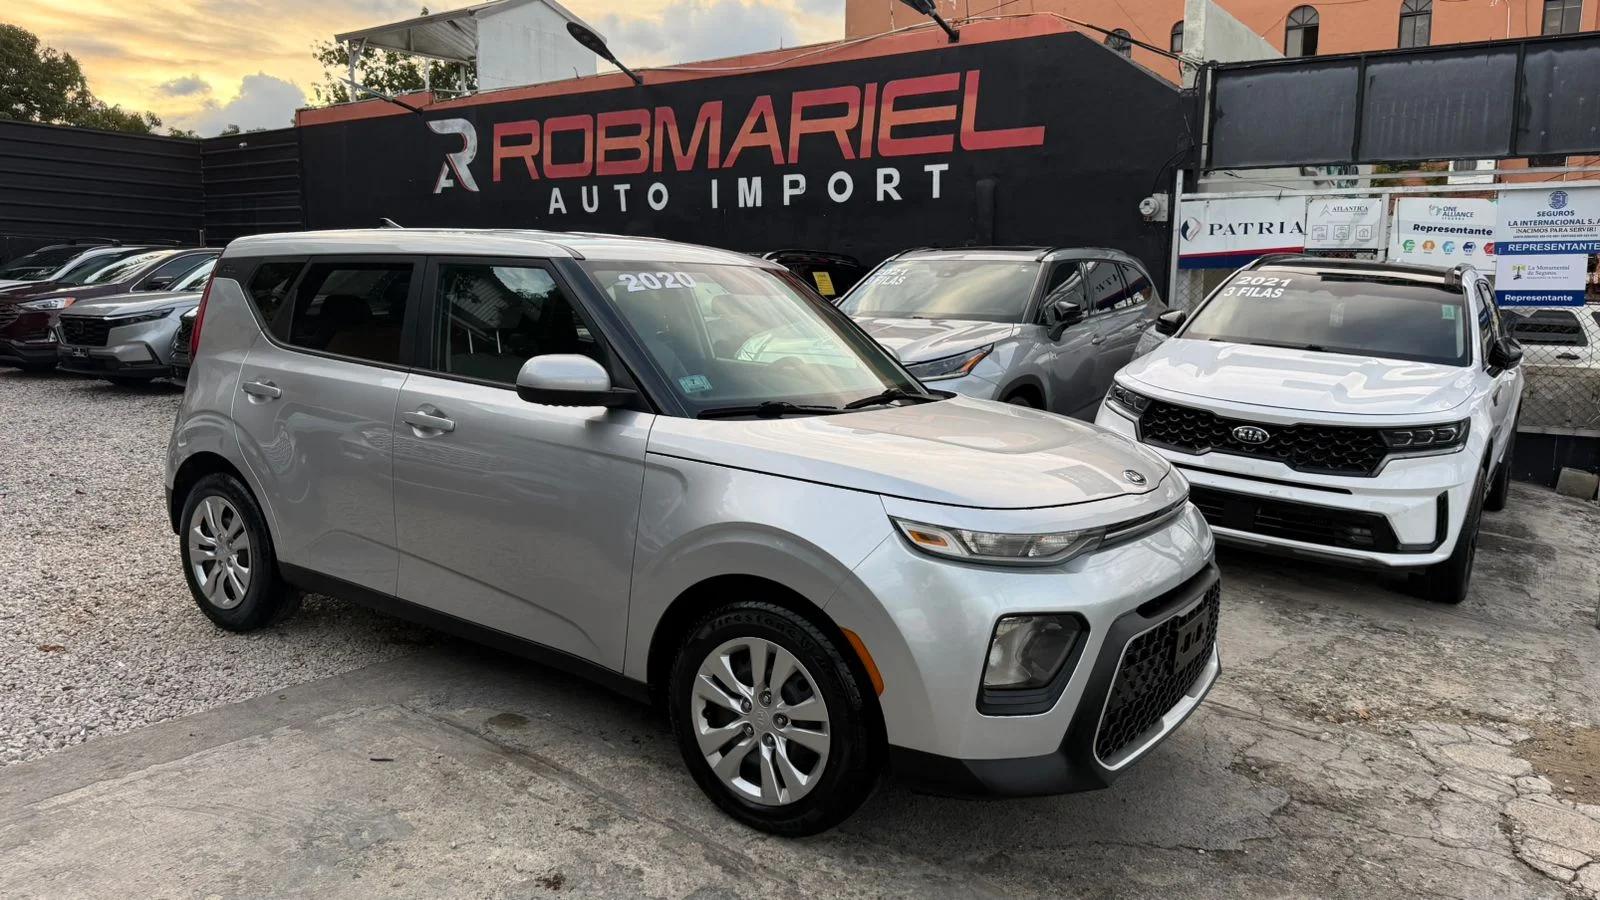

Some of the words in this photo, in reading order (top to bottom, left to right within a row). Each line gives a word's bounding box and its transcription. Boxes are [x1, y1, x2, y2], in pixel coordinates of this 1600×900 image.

[492, 70, 1046, 182] ROBMARIEL
[548, 182, 669, 214] AUTO
[711, 163, 949, 208] IMPORT
[1208, 221, 1304, 236] PATRIA
[1413, 223, 1493, 236] Representante
[1508, 242, 1600, 251] REPRESENTANTE
[618, 271, 696, 292] 2020
[1235, 276, 1293, 287] 2021
[1223, 286, 1234, 297] 3
[1236, 286, 1285, 298] FILAS
[1504, 294, 1573, 302] Representante
[1237, 428, 1263, 442] KIA
